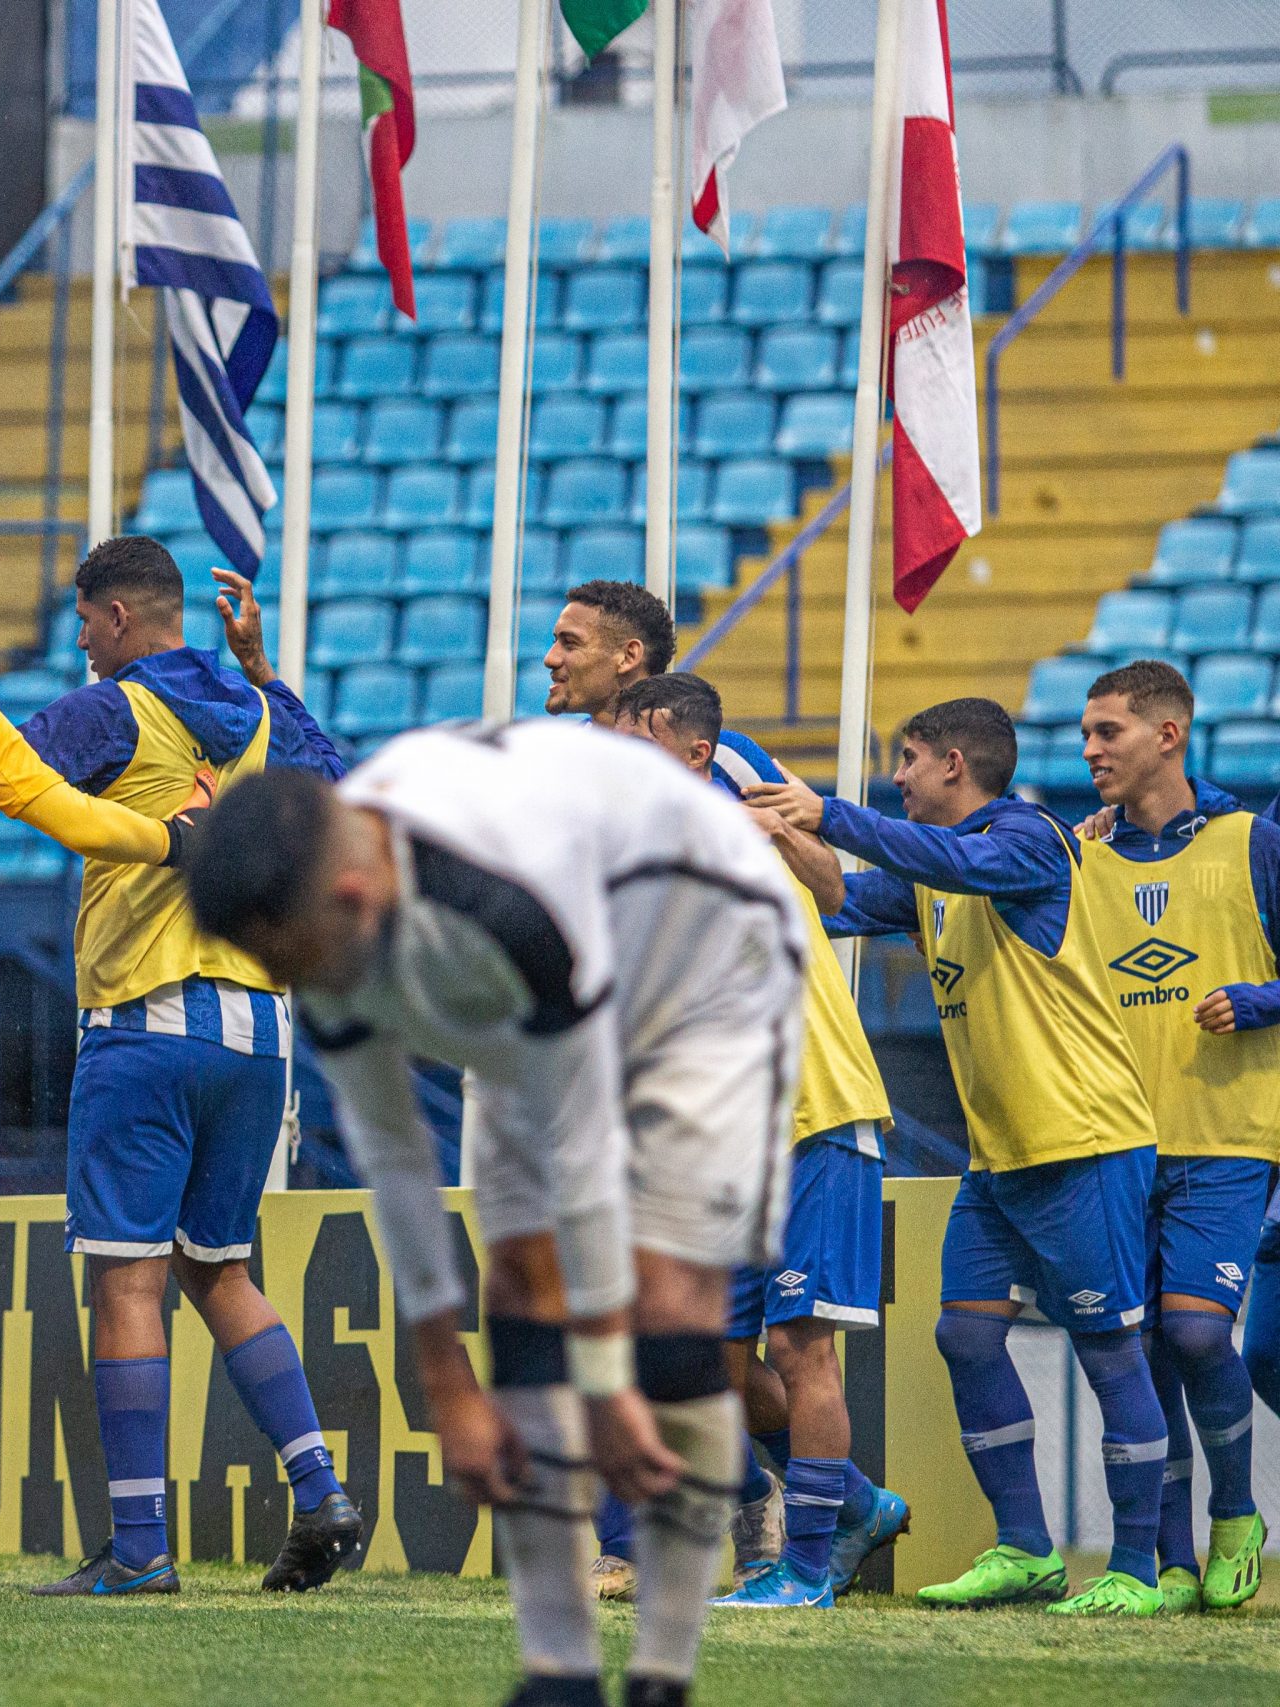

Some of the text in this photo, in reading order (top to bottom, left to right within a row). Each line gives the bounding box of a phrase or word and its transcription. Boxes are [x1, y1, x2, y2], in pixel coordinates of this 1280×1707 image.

[1120, 985, 1190, 1008] umbro
[1215, 1274, 1239, 1292] umbro
[780, 1287, 805, 1297] umbro
[1074, 1306, 1105, 1315] umbro
